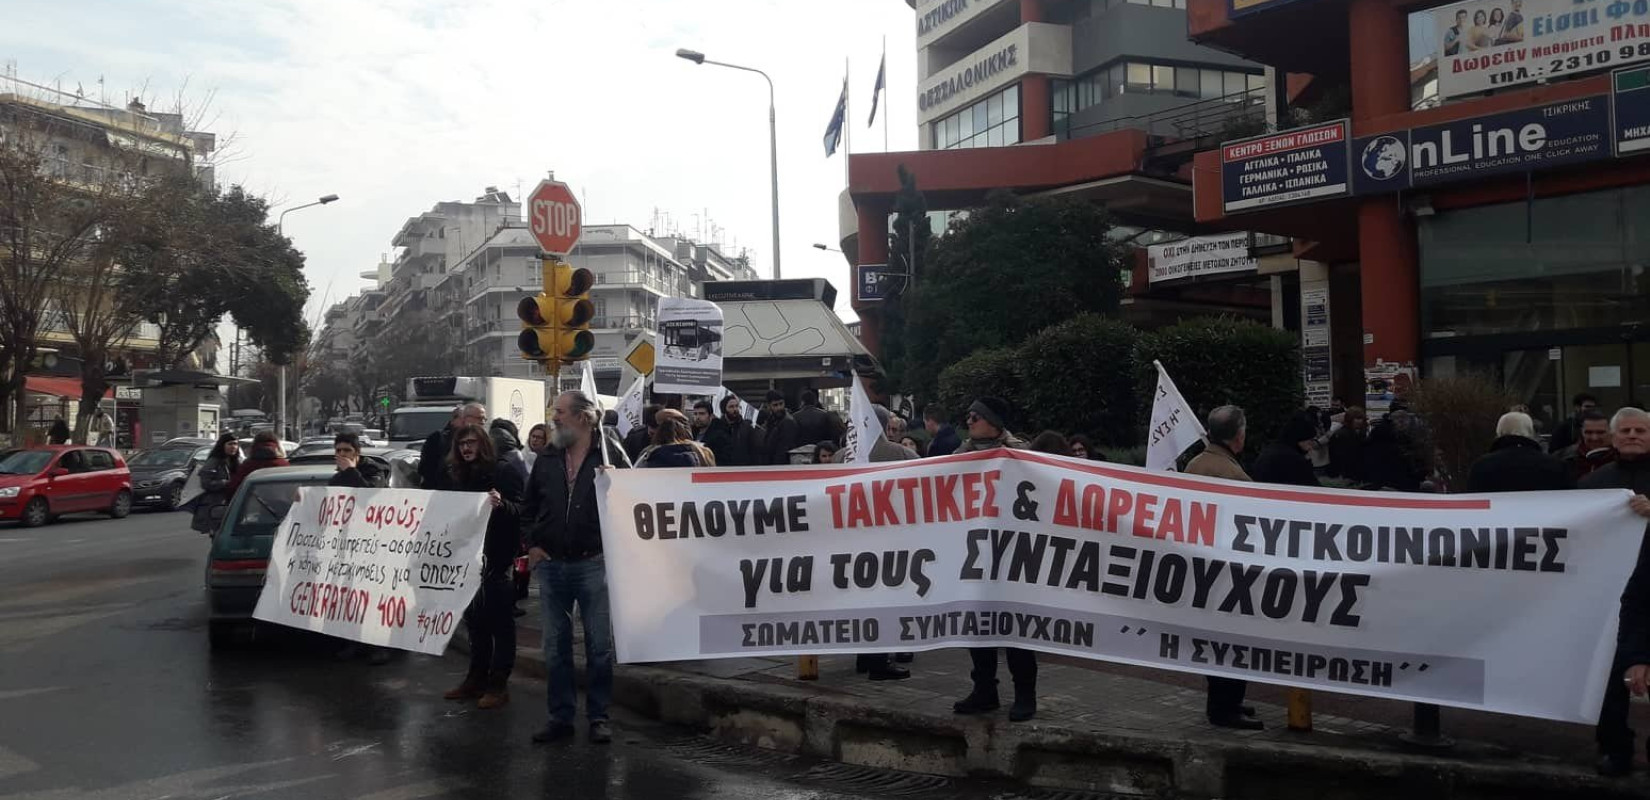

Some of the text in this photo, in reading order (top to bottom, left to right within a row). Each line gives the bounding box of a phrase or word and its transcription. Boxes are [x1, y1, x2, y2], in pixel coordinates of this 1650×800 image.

[1550, 50, 1612, 74] 2310
[1542, 100, 1591, 119] ΤΣΙΚΡΙΚΗΣ
[1229, 127, 1338, 159] ΚΕΝΤΡΟ ΞΕΝΩΝ ΓΛΩΣΣΩΝ
[1548, 133, 1600, 149] EDUCATION
[1239, 159, 1328, 184] ΓΕΡΜΑΝΙΚΑ ΡΩΣΙΚΑ
[1244, 148, 1322, 172] ΑΓΓΛΙΚΑ ΙΤΑΛΙΚΑ
[1413, 143, 1599, 180] PROFESSIONAL EDUCATION ONE CLICK AWAY
[1242, 173, 1327, 197] ΓΑΛΛΙΚΑ ΙΣΠΑΝΙΚΑ
[533, 198, 578, 238] STOP
[319, 494, 356, 526] ΟΑΣΘ
[634, 471, 1568, 573] ΘΕΛΟΥΜΕ ΤΑΚΤΙΚΕΣ & ΔΩΡΕΑΝ ΣΥΓΚΟΙΝΩΝΙΕΣ
[391, 564, 410, 594] για
[740, 528, 1371, 628] για τους ΣΥΝΤΑΞΙΟΥΧΟΥΣ
[290, 581, 370, 625] GENERATION
[742, 618, 880, 648] ΣΩΜΑΤΕΙΟ
[899, 610, 1095, 648] ΣΥΝΤΑΞΙΟΥΧΩΝ
[1159, 634, 1180, 661] Η
